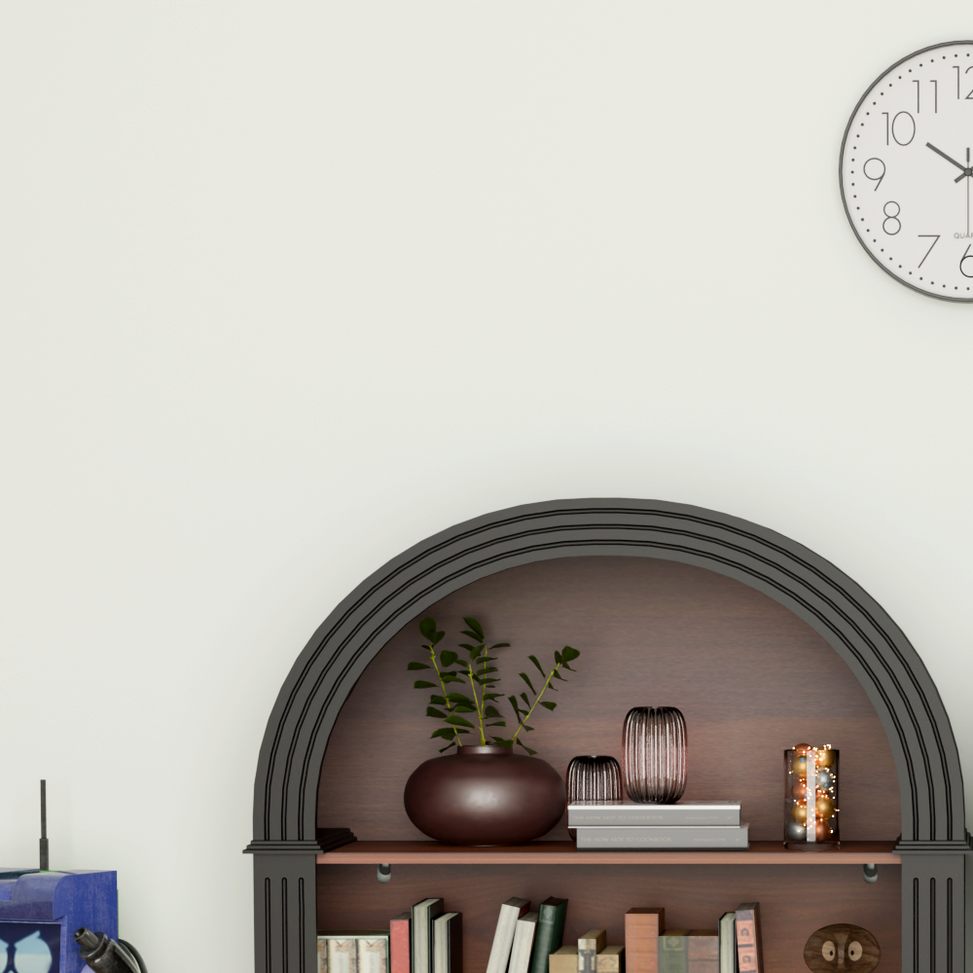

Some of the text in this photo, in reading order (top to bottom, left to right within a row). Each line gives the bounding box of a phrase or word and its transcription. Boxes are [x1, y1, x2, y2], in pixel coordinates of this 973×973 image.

[912, 80, 938, 114] 11
[881, 110, 916, 146] 10
[863, 157, 887, 192] 9
[882, 200, 902, 236] 8
[917, 234, 941, 269] 7
